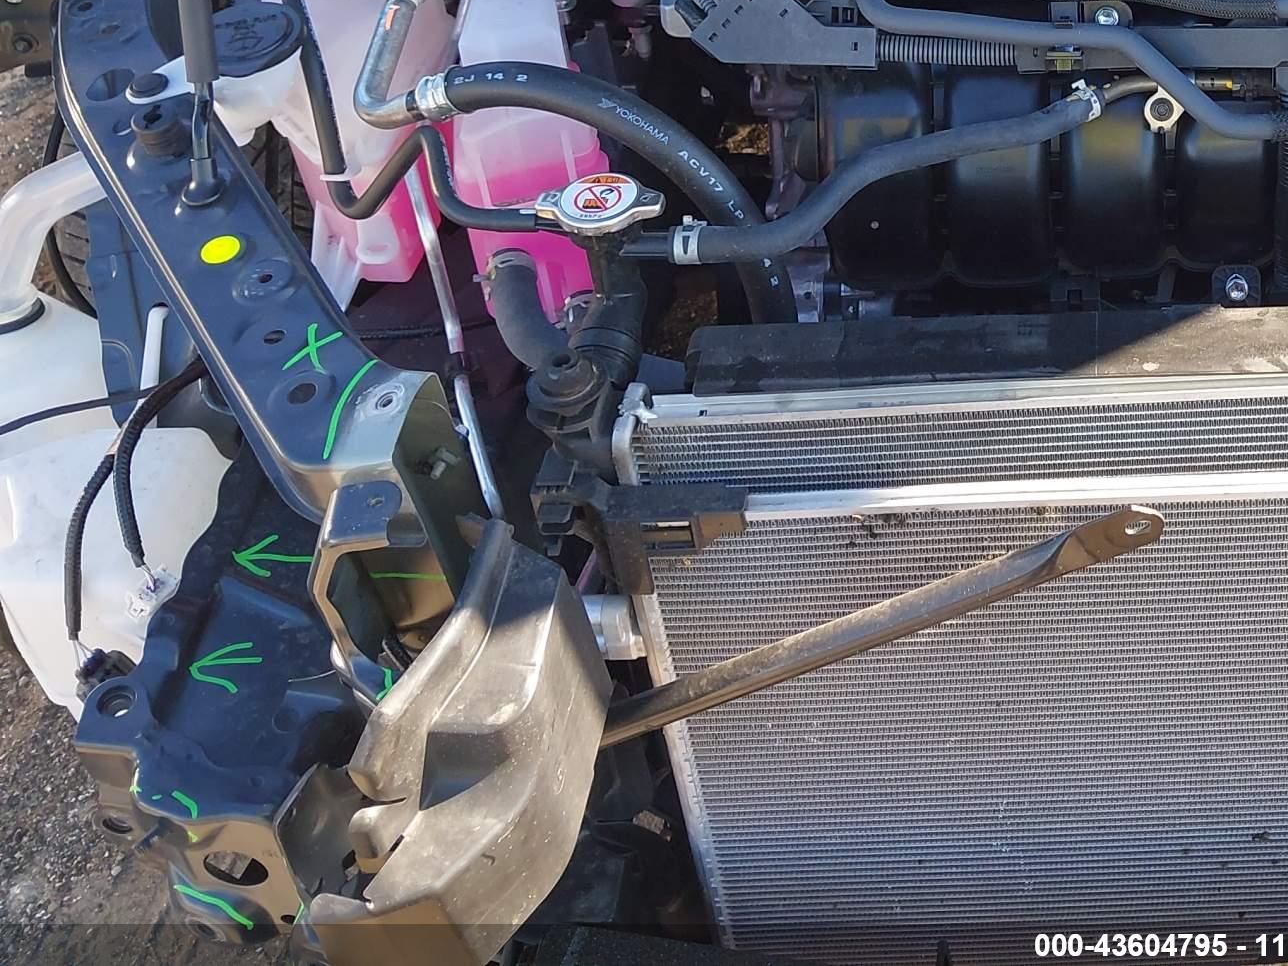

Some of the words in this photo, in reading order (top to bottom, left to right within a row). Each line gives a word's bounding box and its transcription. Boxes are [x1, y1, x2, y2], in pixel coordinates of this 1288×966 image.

[485, 72, 505, 81] 14
[515, 74, 528, 82] 2
[614, 105, 670, 146] YOKOHAMA
[677, 149, 724, 193] ACV17
[726, 199, 745, 221] LP
